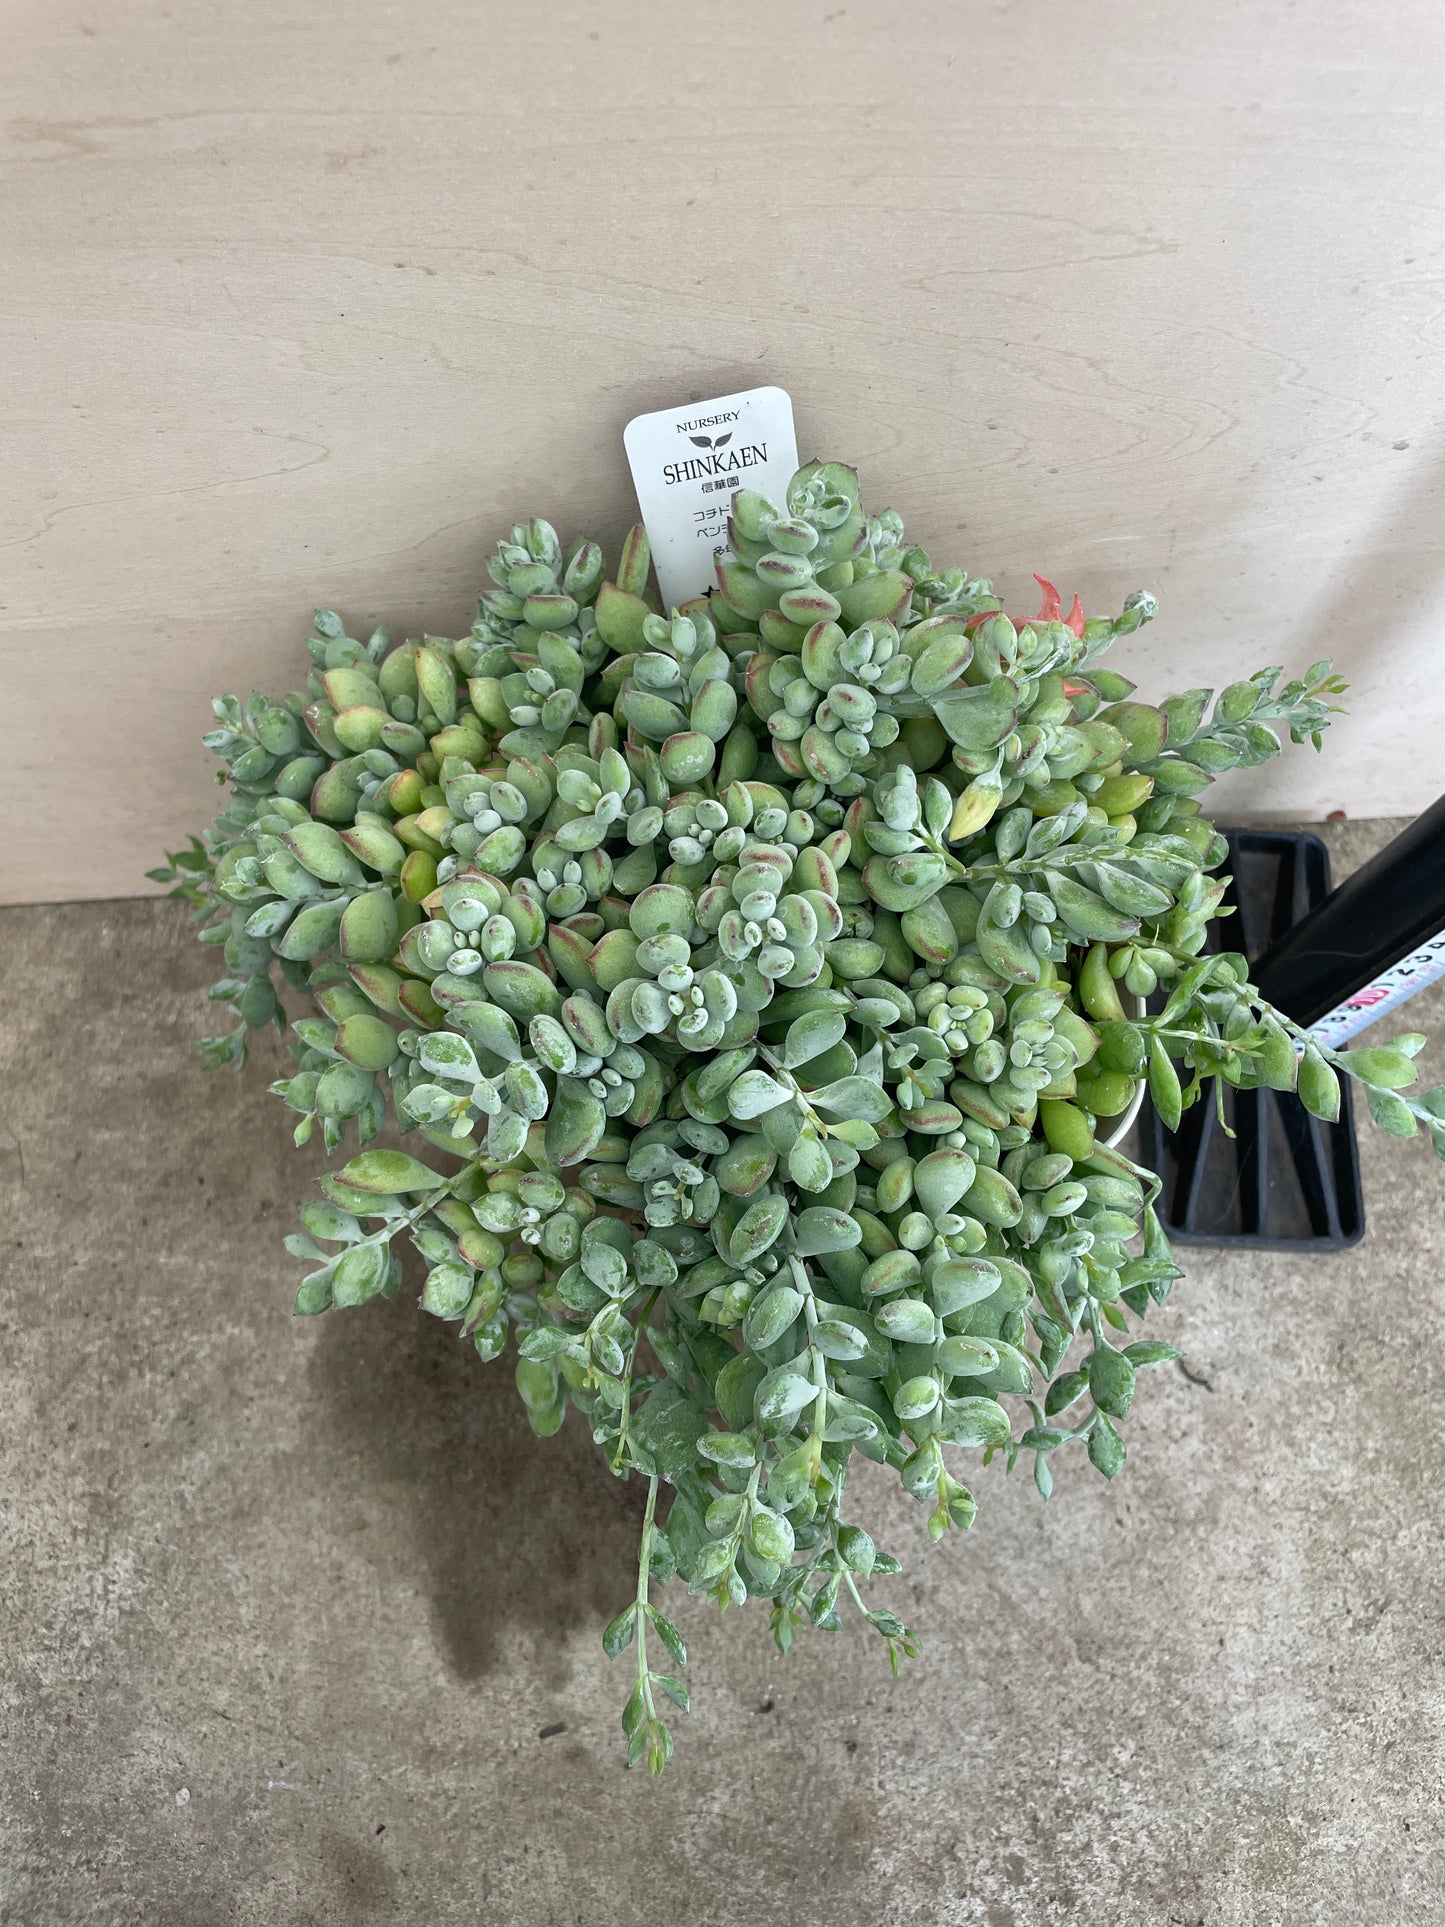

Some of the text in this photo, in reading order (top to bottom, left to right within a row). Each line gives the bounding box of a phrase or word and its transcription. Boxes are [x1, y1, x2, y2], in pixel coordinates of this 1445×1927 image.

[676, 410, 741, 433] NURSERY
[663, 443, 768, 485] SHINKAEN
[701, 476, 740, 494] 信華園
